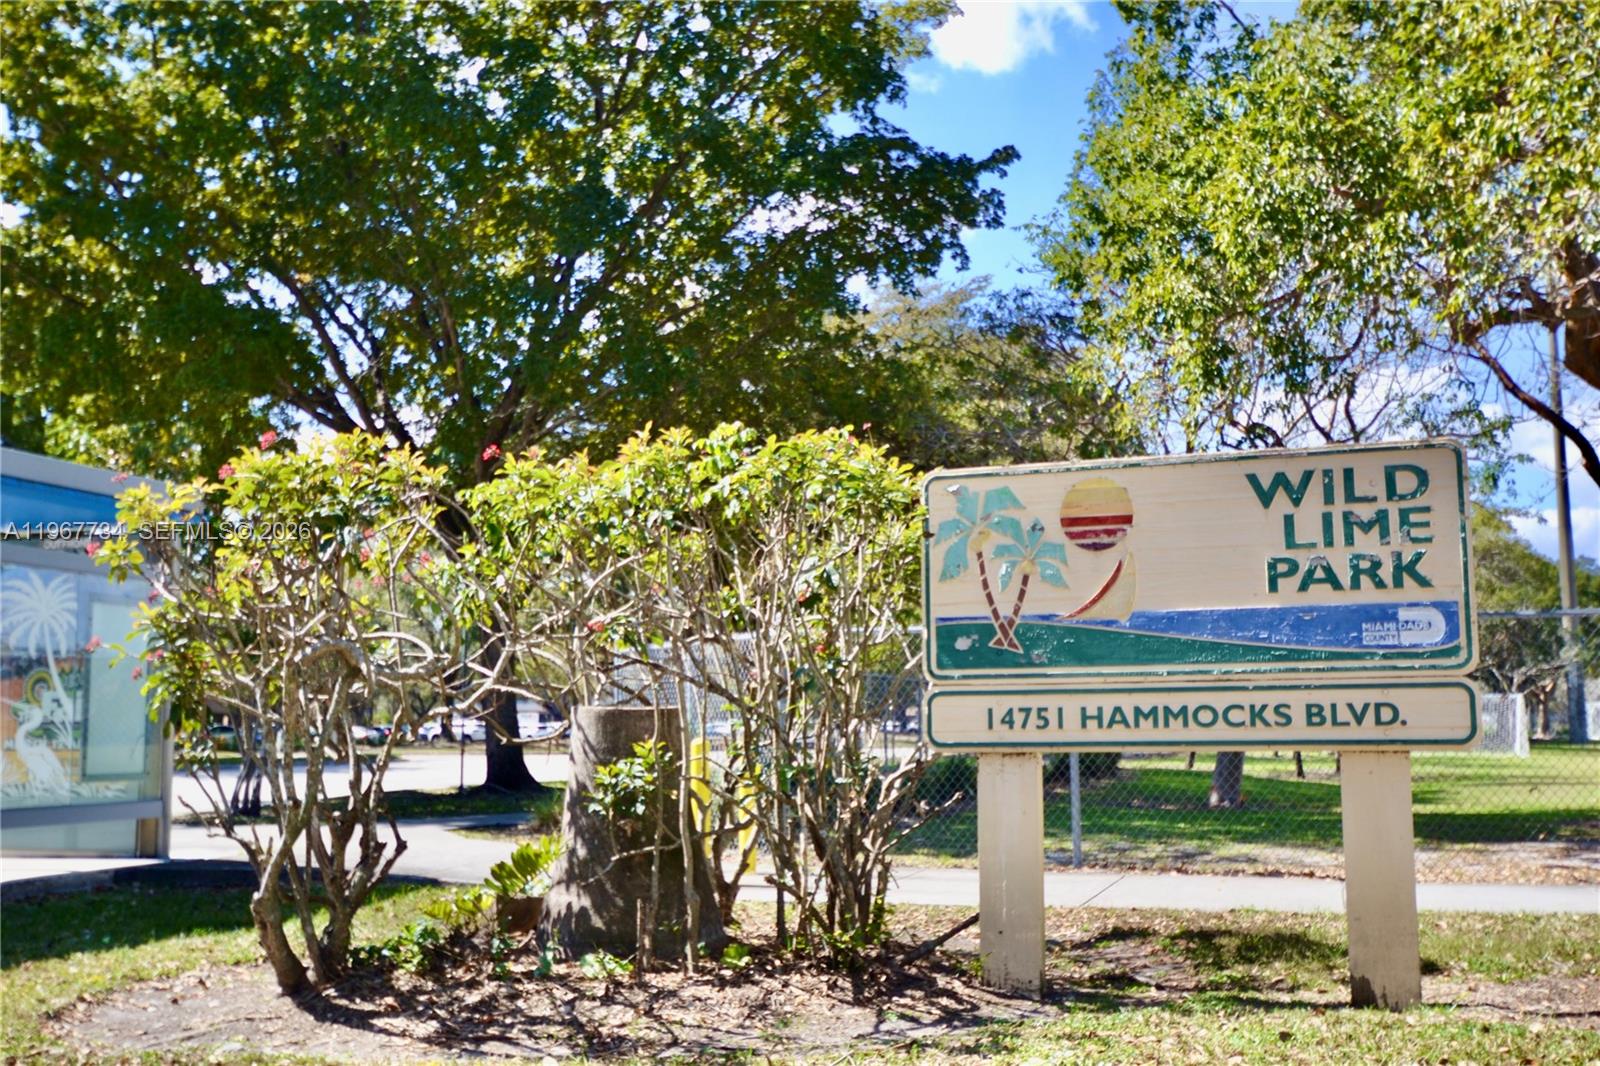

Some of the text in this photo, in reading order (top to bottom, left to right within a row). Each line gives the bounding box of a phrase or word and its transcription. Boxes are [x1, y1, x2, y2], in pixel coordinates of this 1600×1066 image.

[1245, 464, 1430, 509] WILD
[1283, 506, 1434, 550] LIME
[1265, 549, 1434, 594] PARK
[987, 702, 1407, 730] 14751 HAMMOCKS BLVD.
